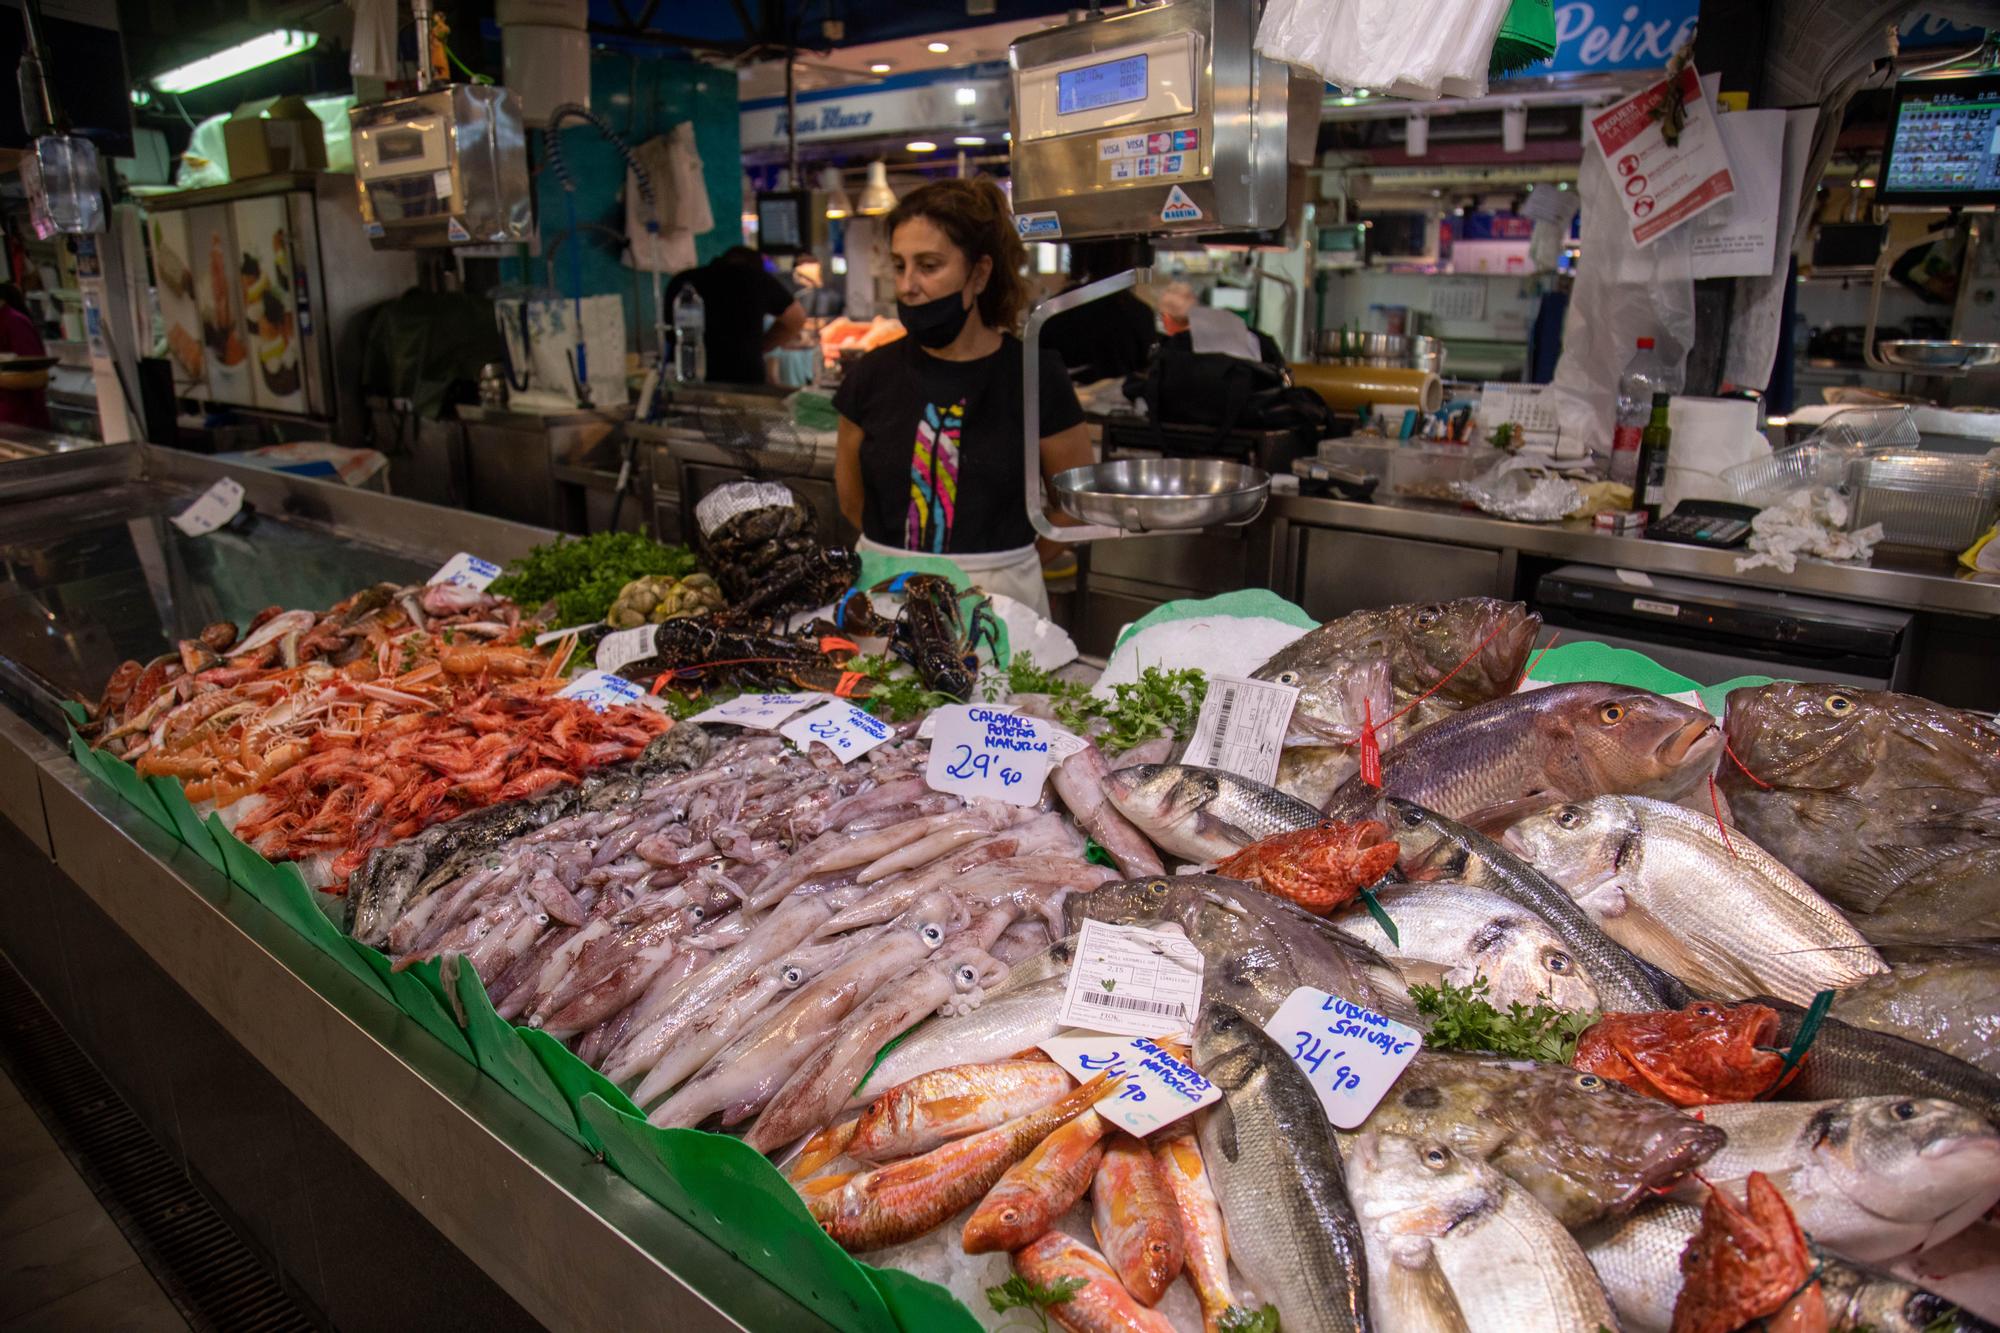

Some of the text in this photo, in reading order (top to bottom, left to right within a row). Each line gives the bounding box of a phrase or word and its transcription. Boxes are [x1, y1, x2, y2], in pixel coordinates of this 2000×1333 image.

[1103, 144, 1120, 155] VISA
[1126, 139, 1144, 150] VISA
[1322, 996, 1389, 1028] LUBINA
